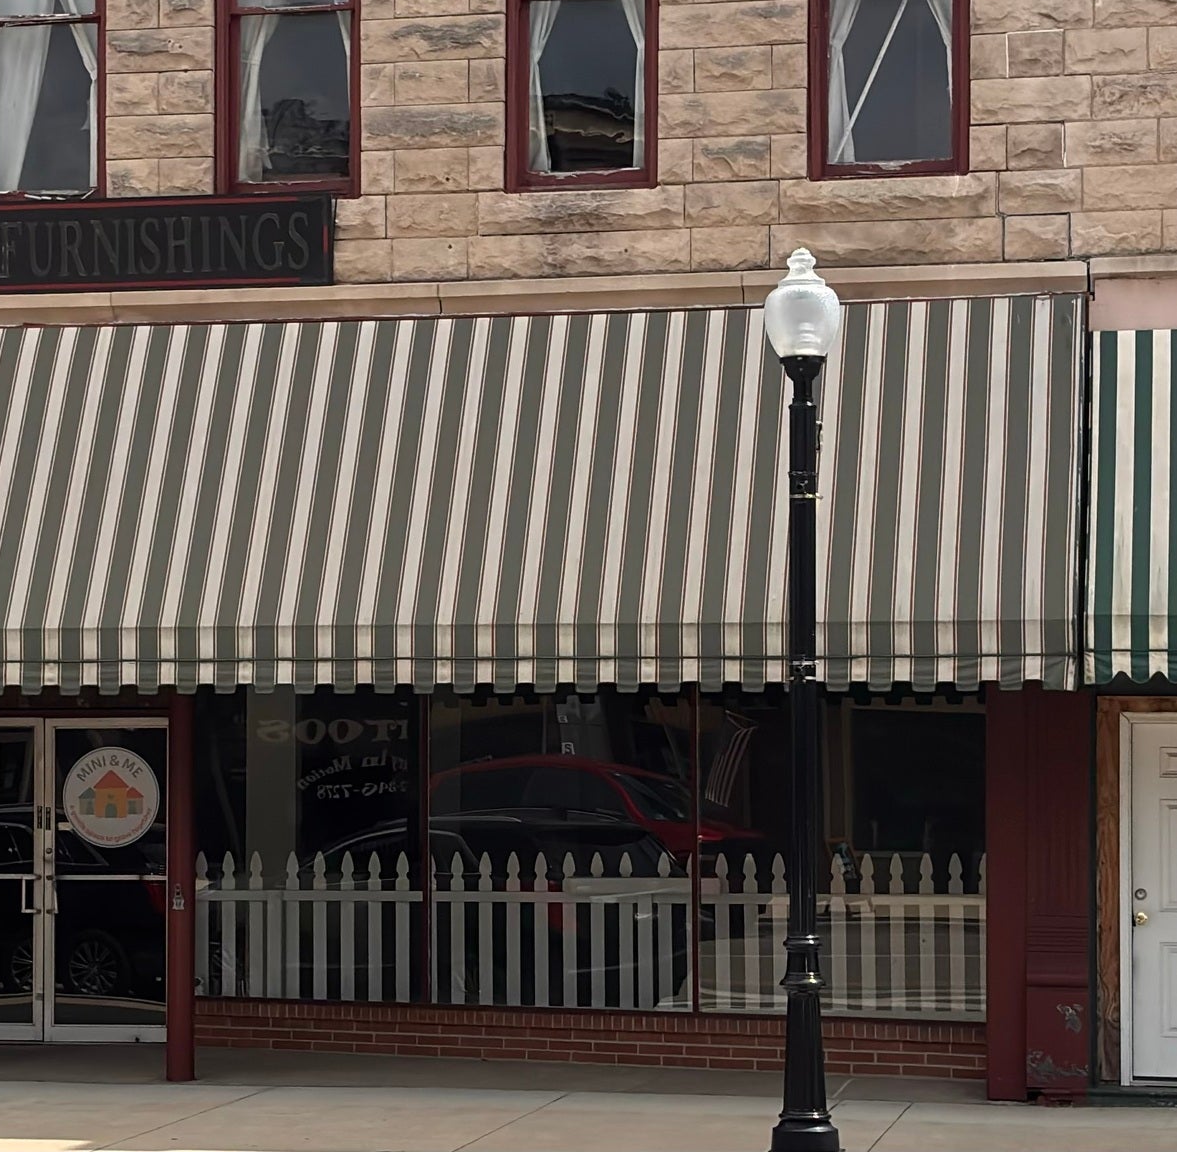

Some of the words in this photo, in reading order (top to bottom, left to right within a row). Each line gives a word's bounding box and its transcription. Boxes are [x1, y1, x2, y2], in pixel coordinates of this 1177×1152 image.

[0, 211, 311, 282] FURNISHINGS
[76, 756, 106, 782] MINI
[109, 754, 120, 767] &
[121, 758, 144, 778] ME
